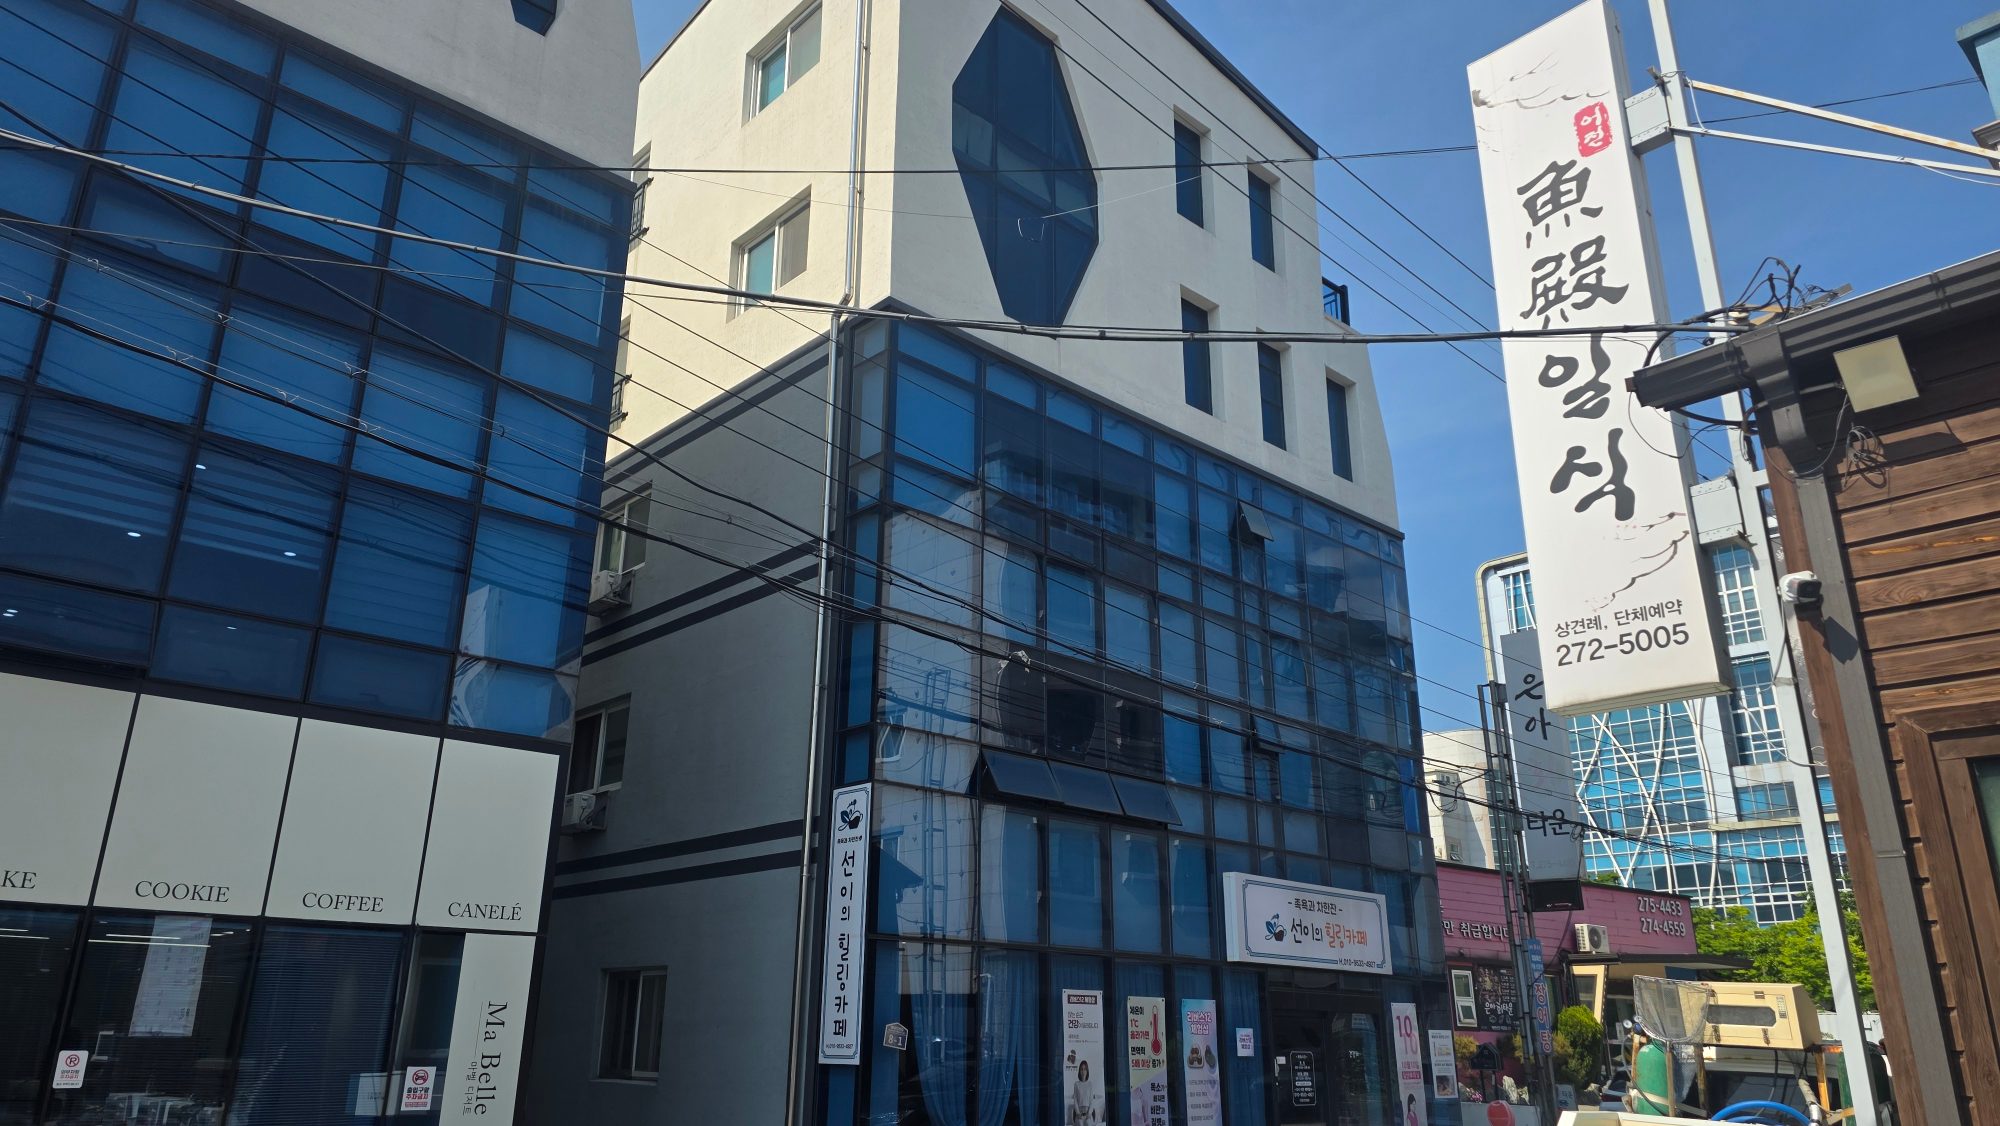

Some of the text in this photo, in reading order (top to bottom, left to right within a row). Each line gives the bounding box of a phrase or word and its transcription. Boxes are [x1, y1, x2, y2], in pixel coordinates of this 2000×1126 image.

[1580, 105, 1605, 147] 어전
[1555, 599, 1683, 638] 상견례, 단체예약
[1556, 622, 1690, 667] 272-5005
[0, 870, 37, 889] KE
[135, 880, 230, 902] COOKIE
[302, 892, 384, 913] COFFEE
[448, 901, 522, 921] CANELÉ
[1294, 898, 1316, 912] 족욕과
[1638, 896, 1682, 916] 275-4433
[1290, 918, 1368, 948] 선이의 힐링카페
[1640, 917, 1686, 937] 274-4559
[833, 849, 855, 1038] 선이의 힐링카페
[1396, 1015, 1412, 1037] 10
[474, 1000, 508, 1115] Ma Belle
[463, 1086, 474, 1116] 디저트
